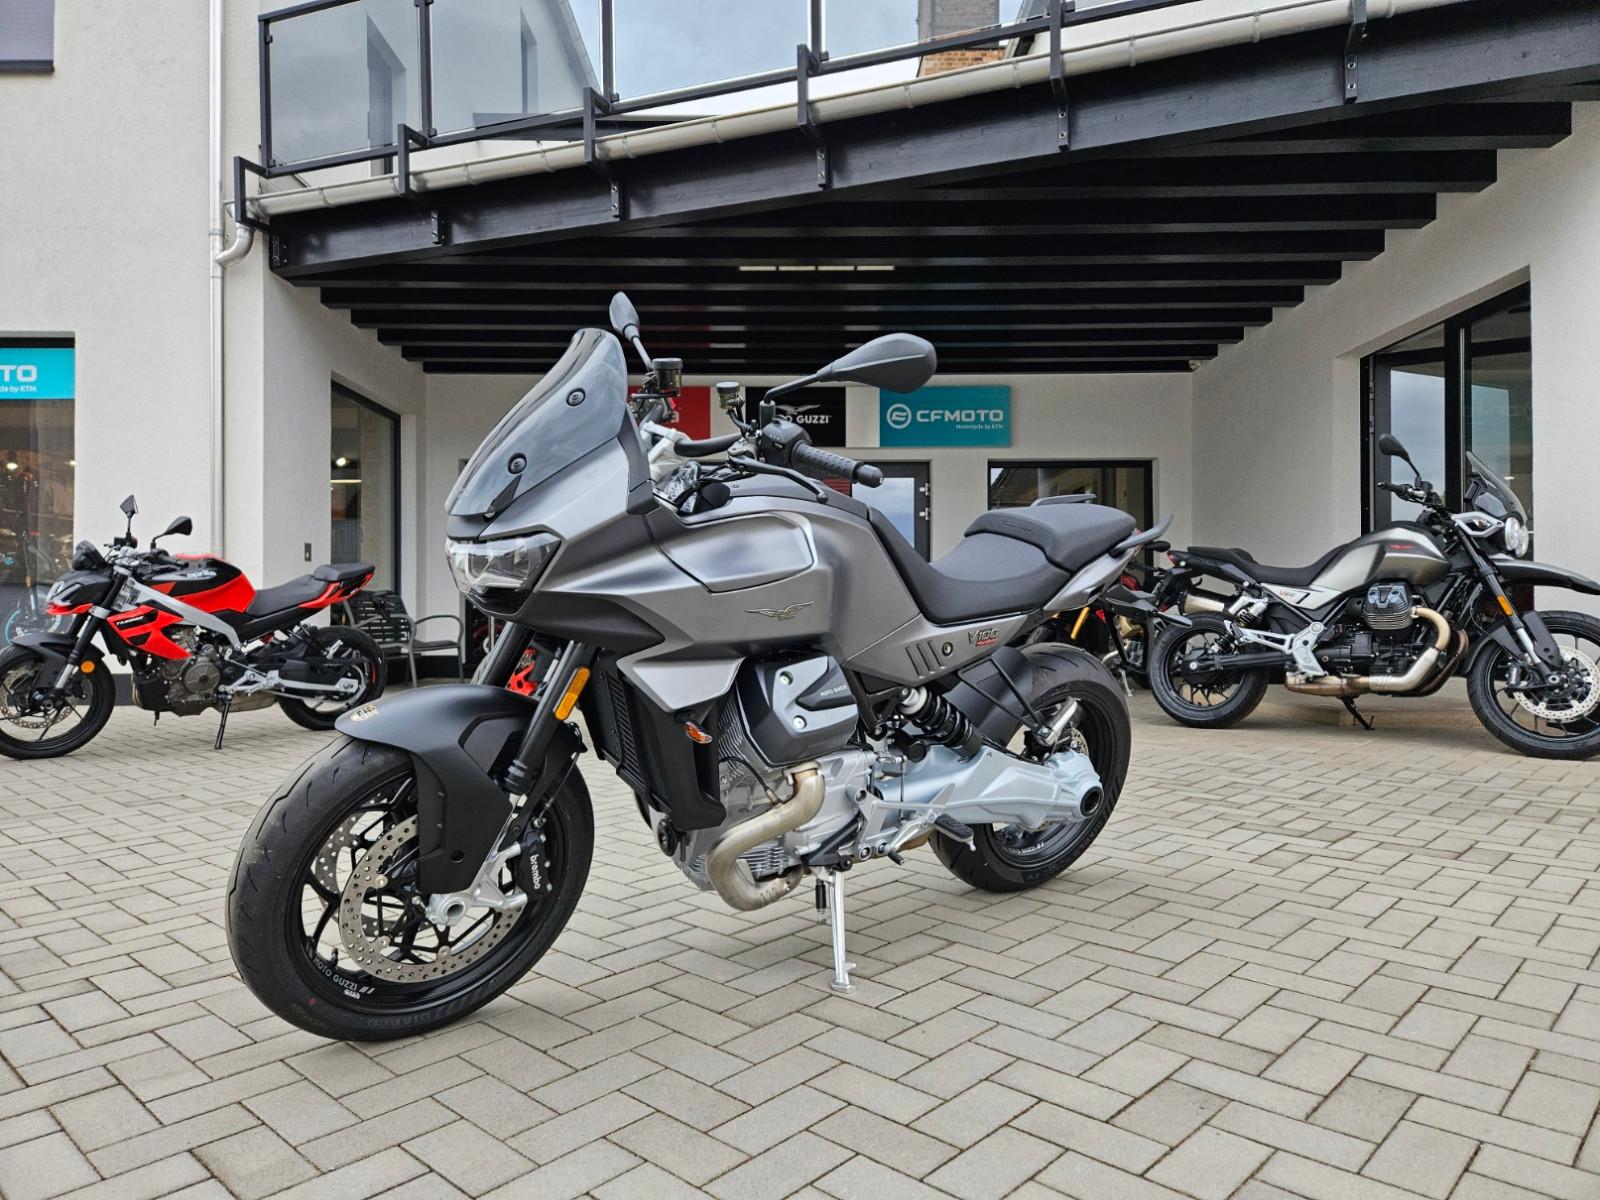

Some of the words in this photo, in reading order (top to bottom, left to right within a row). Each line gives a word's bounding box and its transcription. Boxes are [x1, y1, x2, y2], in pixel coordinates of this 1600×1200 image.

[796, 414, 829, 424] GUZZI
[916, 410, 1004, 422] CFMOTO
[530, 853, 542, 890] brembo
[333, 974, 358, 991] GUZZI
